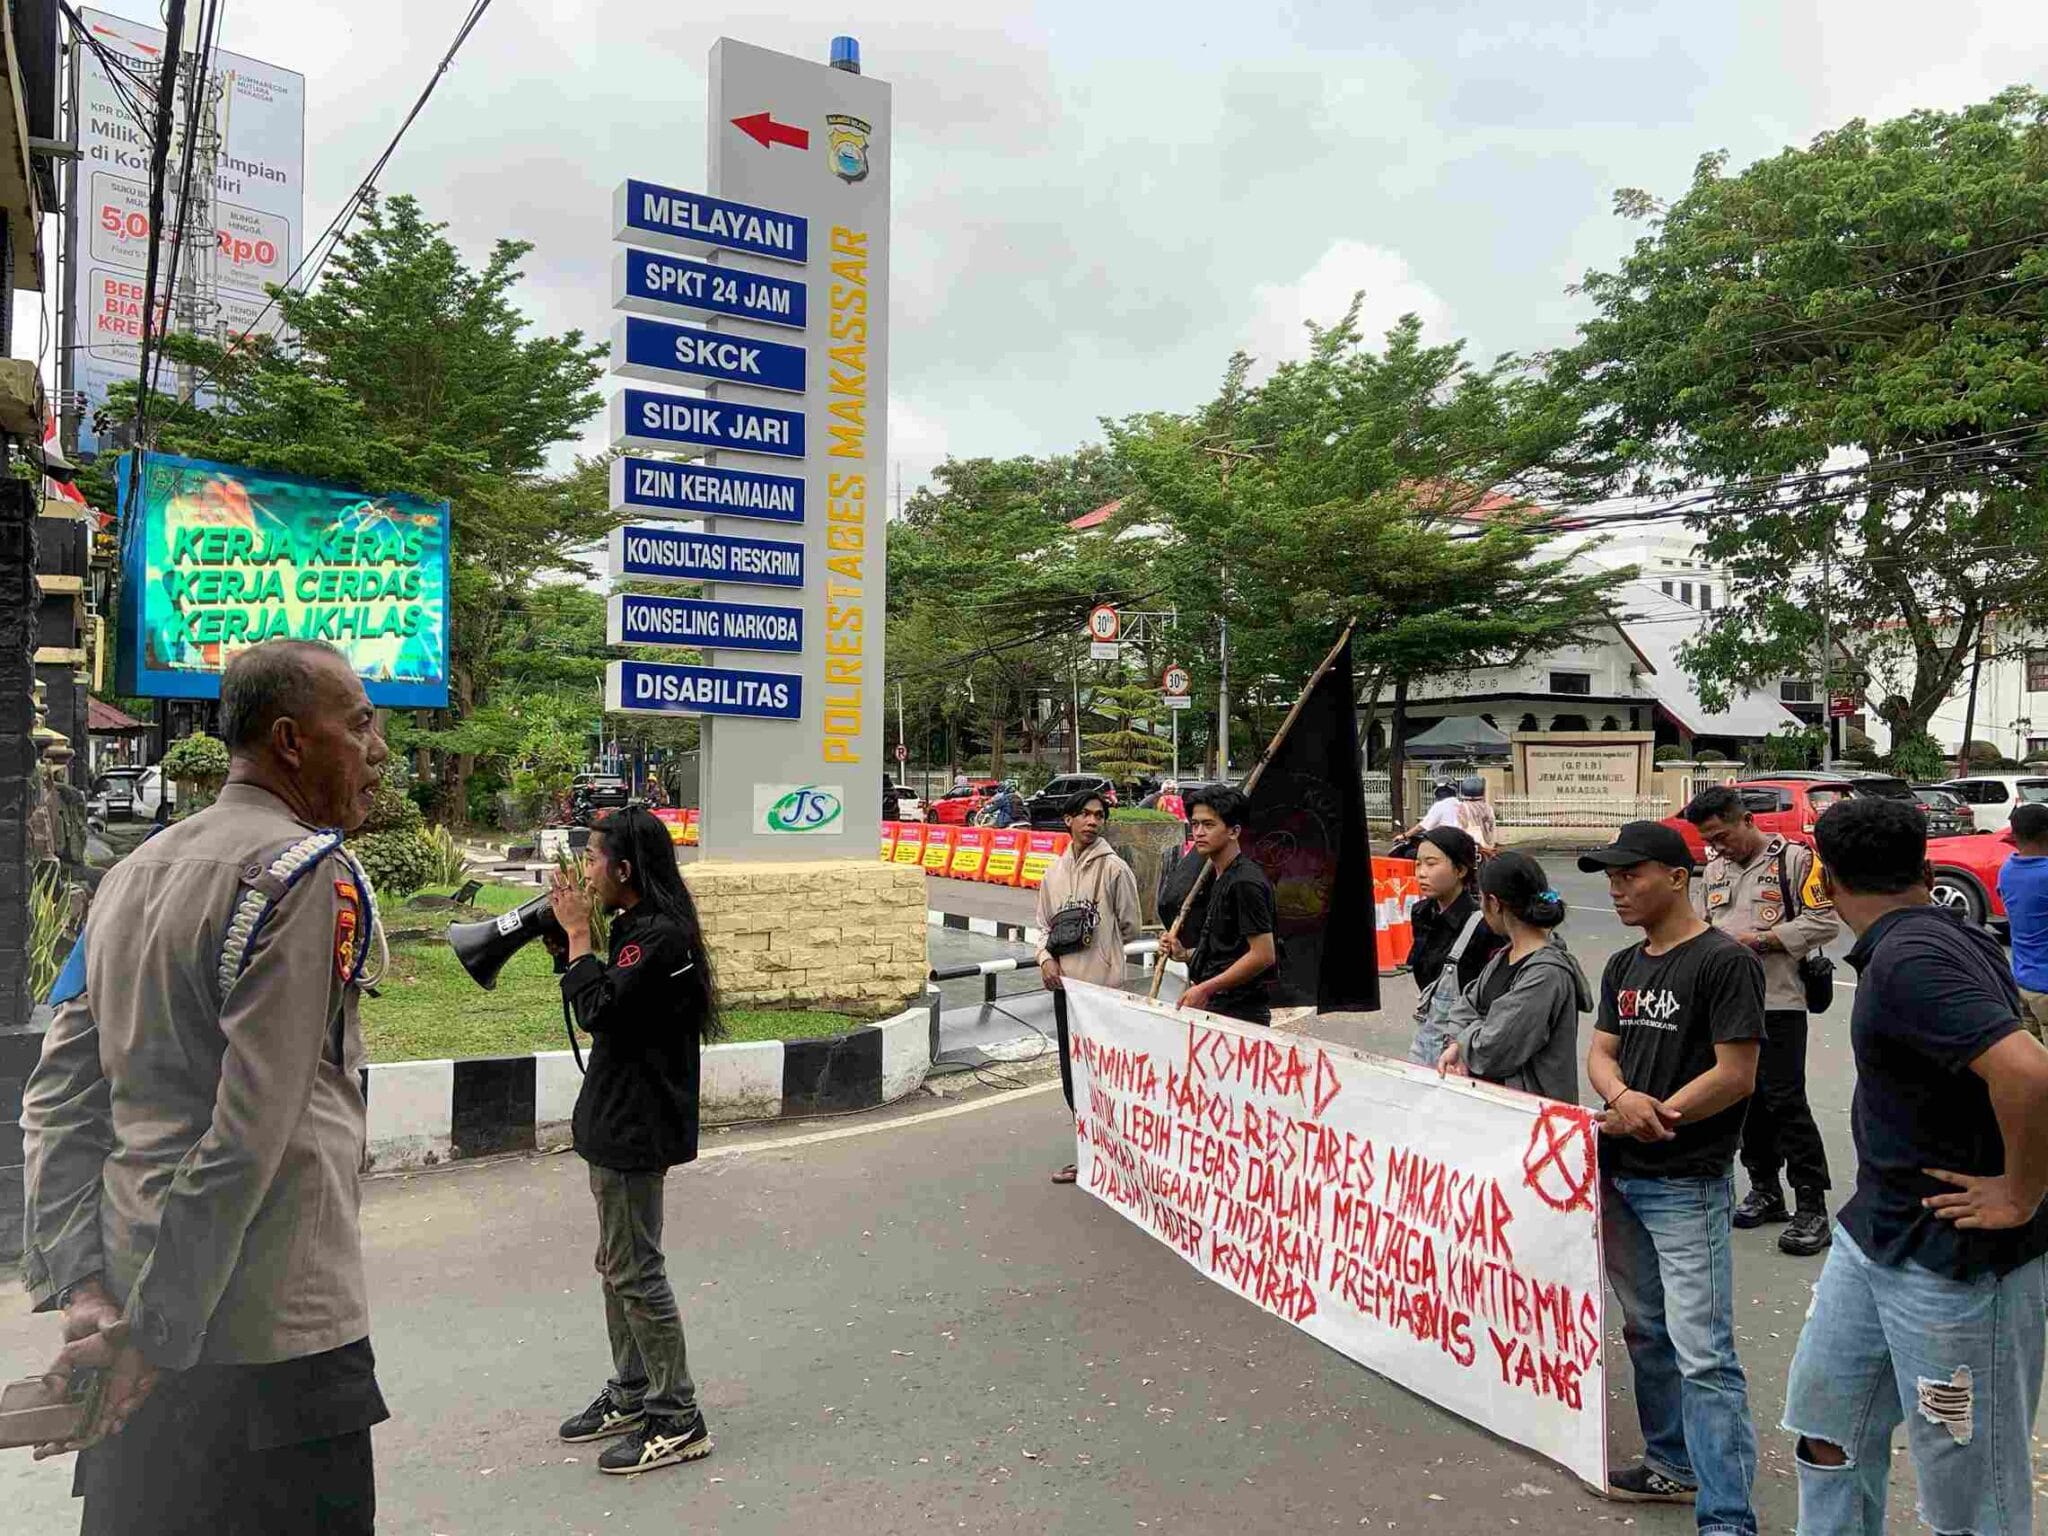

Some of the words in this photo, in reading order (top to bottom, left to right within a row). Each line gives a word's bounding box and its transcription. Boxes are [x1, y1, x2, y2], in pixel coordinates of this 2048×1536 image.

[90, 145, 109, 161] di
[115, 149, 149, 171] Kot
[643, 193, 794, 251] MELAYANI
[104, 279, 143, 300] BEB
[105, 298, 140, 318] BIA
[645, 262, 707, 299] SPKT
[712, 277, 738, 304] 24
[743, 283, 791, 315] JAM
[675, 336, 762, 375] SKCK
[828, 224, 869, 459] MAKASSAR
[642, 401, 722, 437] SIDIK
[729, 414, 790, 445] JARI
[635, 468, 675, 500] IZIN
[680, 474, 796, 513] KERAMAIAN
[172, 527, 298, 567] KERJA
[307, 529, 423, 567] KERAS
[627, 536, 726, 571] KONSULTASI
[731, 545, 800, 577] RESKRIM
[168, 570, 285, 605] KERJA
[295, 570, 423, 604] CERDAS
[168, 608, 291, 646] KERJA
[301, 604, 424, 641] IKHLAS
[626, 605, 720, 636] KONSELING
[723, 612, 798, 642] NARKOBA
[823, 473, 867, 764] POLRESTABES
[635, 673, 789, 710] DISABILITAS
[1188, 1020, 1342, 1119] KOMRAD
[1166, 1058, 1375, 1199] KAPOLRESTABES
[1385, 1145, 1515, 1263] MAKASSAR
[1122, 1101, 1172, 1161] LEBIH
[1177, 1123, 1241, 1195] TEGAS
[1246, 1157, 1322, 1238] DALAM
[1331, 1190, 1439, 1293] MENJAGA
[1447, 1243, 1600, 1371] KAMTIBMAS
[1139, 1155, 1211, 1217] DUGAAN
[1211, 1190, 1324, 1281] TINDAKAN
[1488, 1326, 1583, 1411] YANG
[1152, 1201, 1203, 1265] KADER
[1211, 1230, 1317, 1325] KOMRAD
